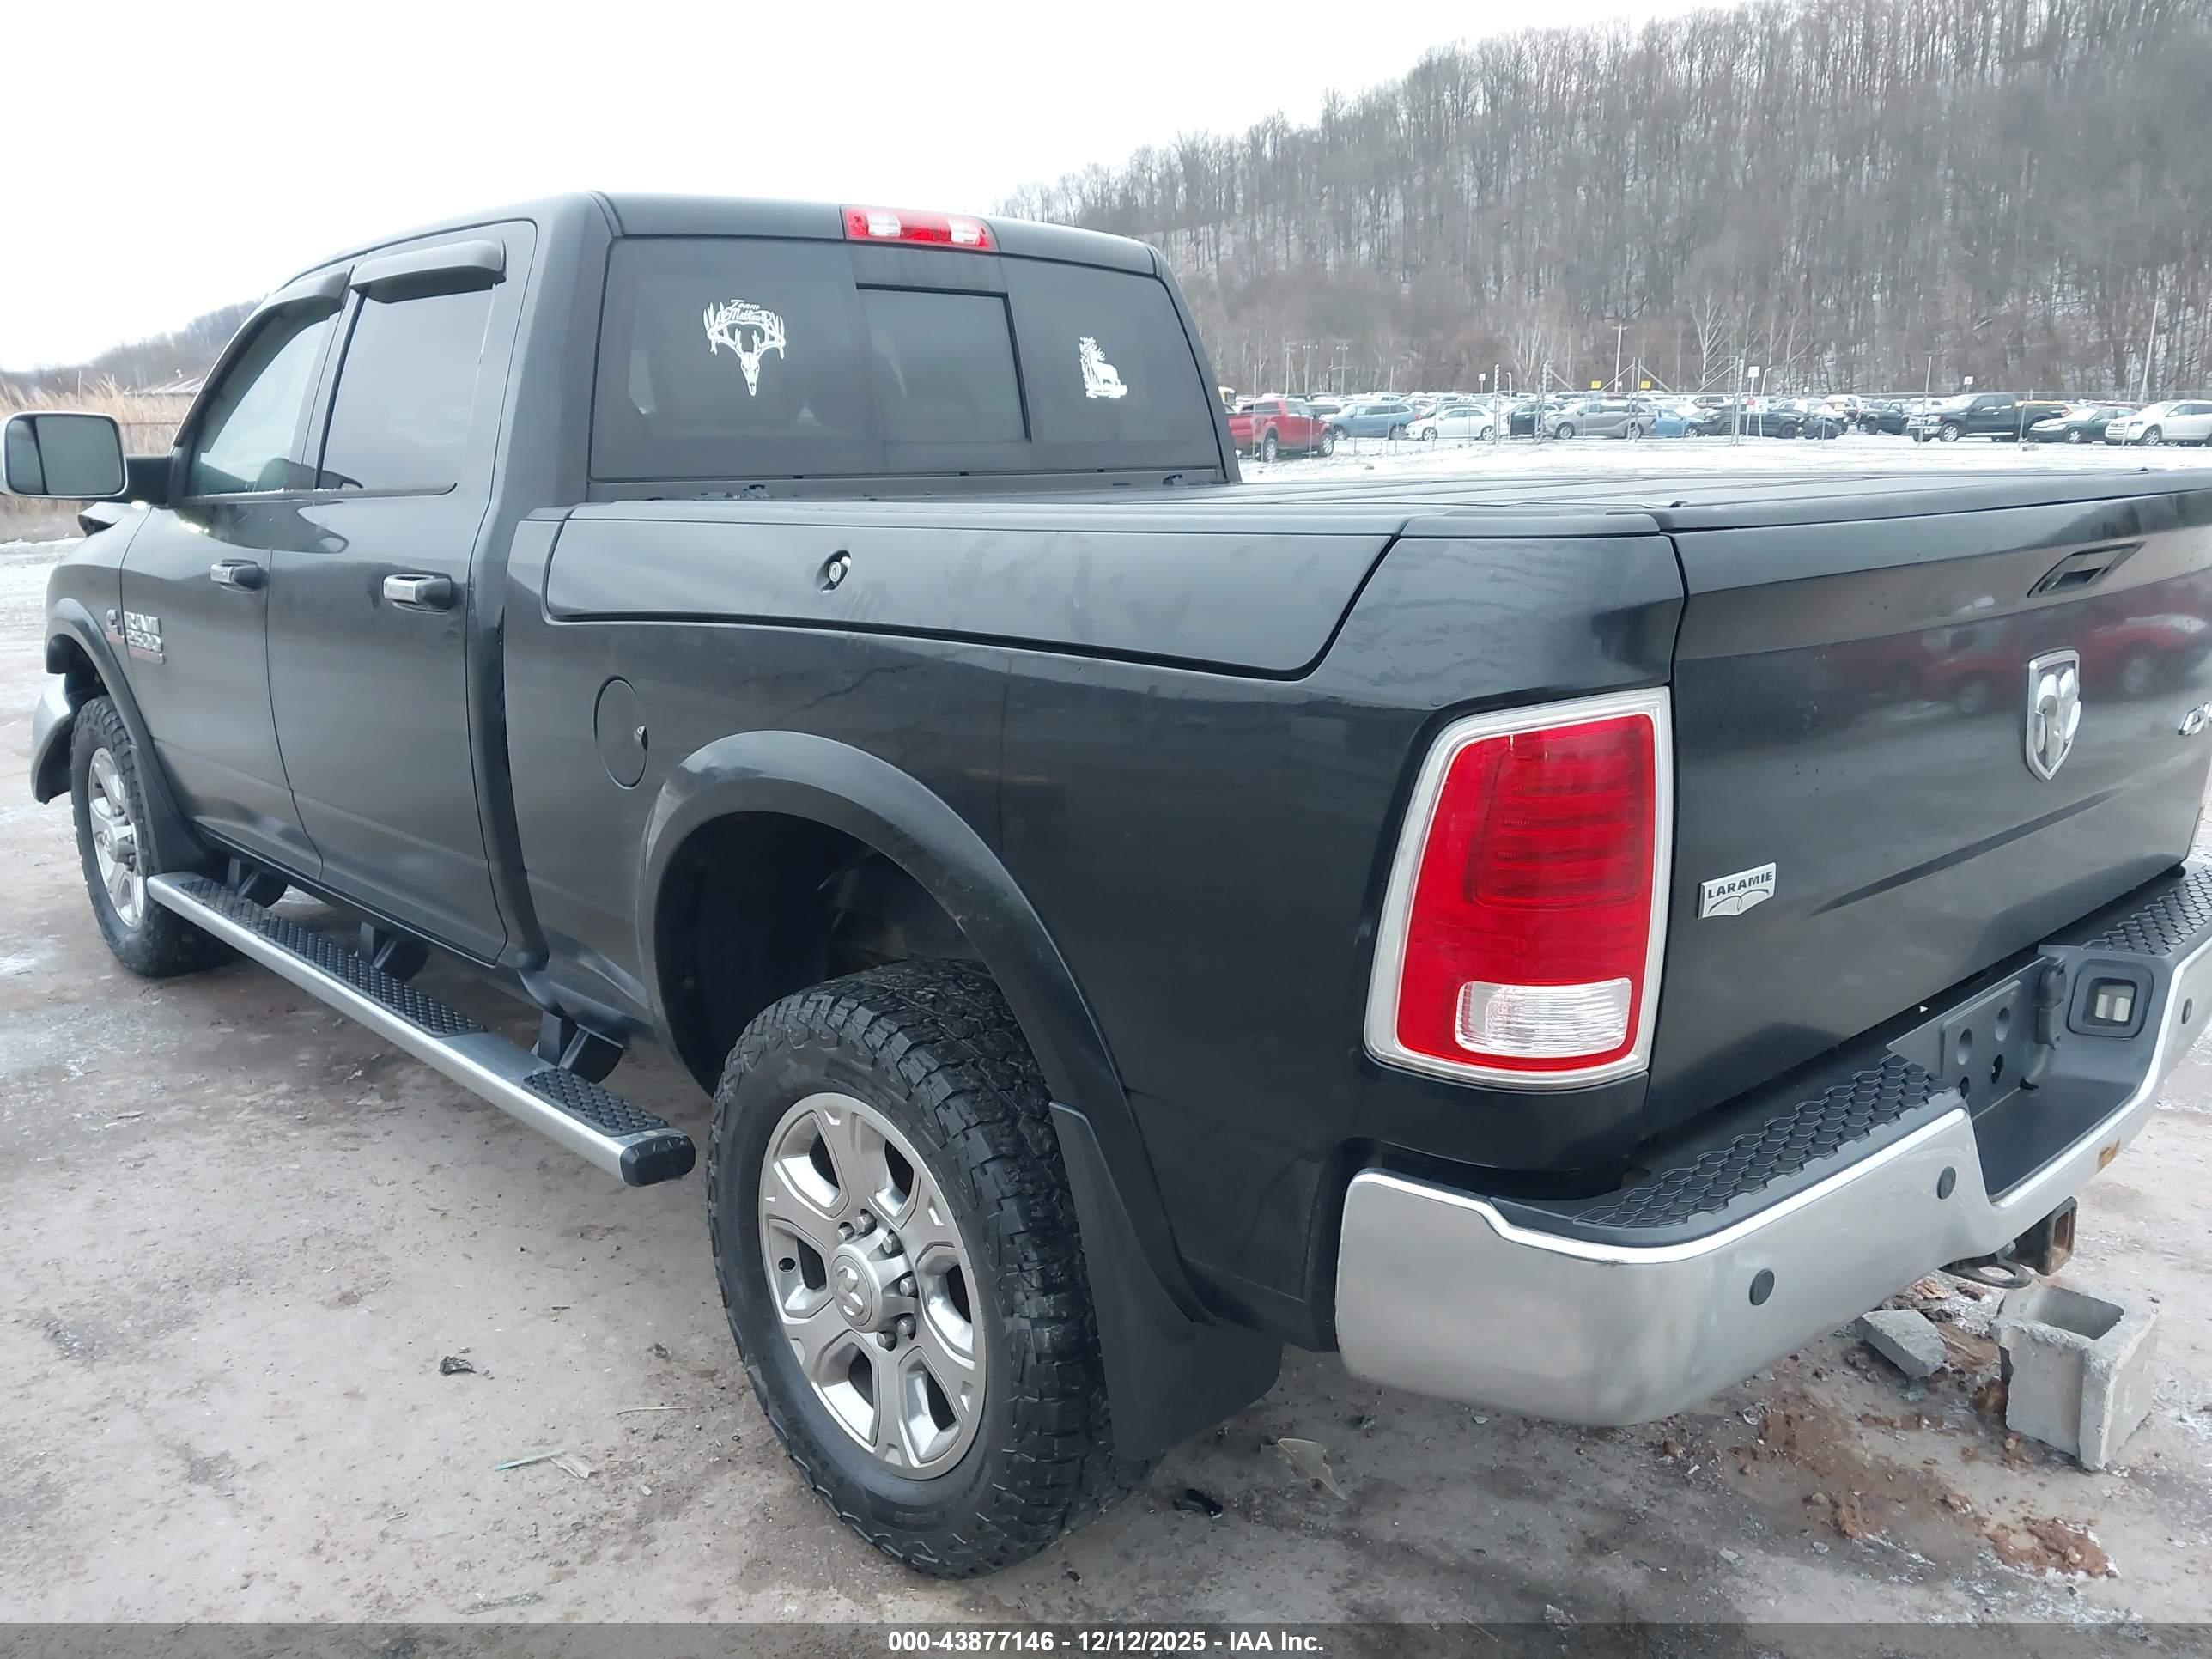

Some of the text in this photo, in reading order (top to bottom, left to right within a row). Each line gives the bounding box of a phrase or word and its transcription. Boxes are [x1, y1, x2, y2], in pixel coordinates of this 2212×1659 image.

[124, 611, 161, 635] RAM
[126, 629, 162, 653] 2500
[1707, 871, 1773, 900] LARAMIE
